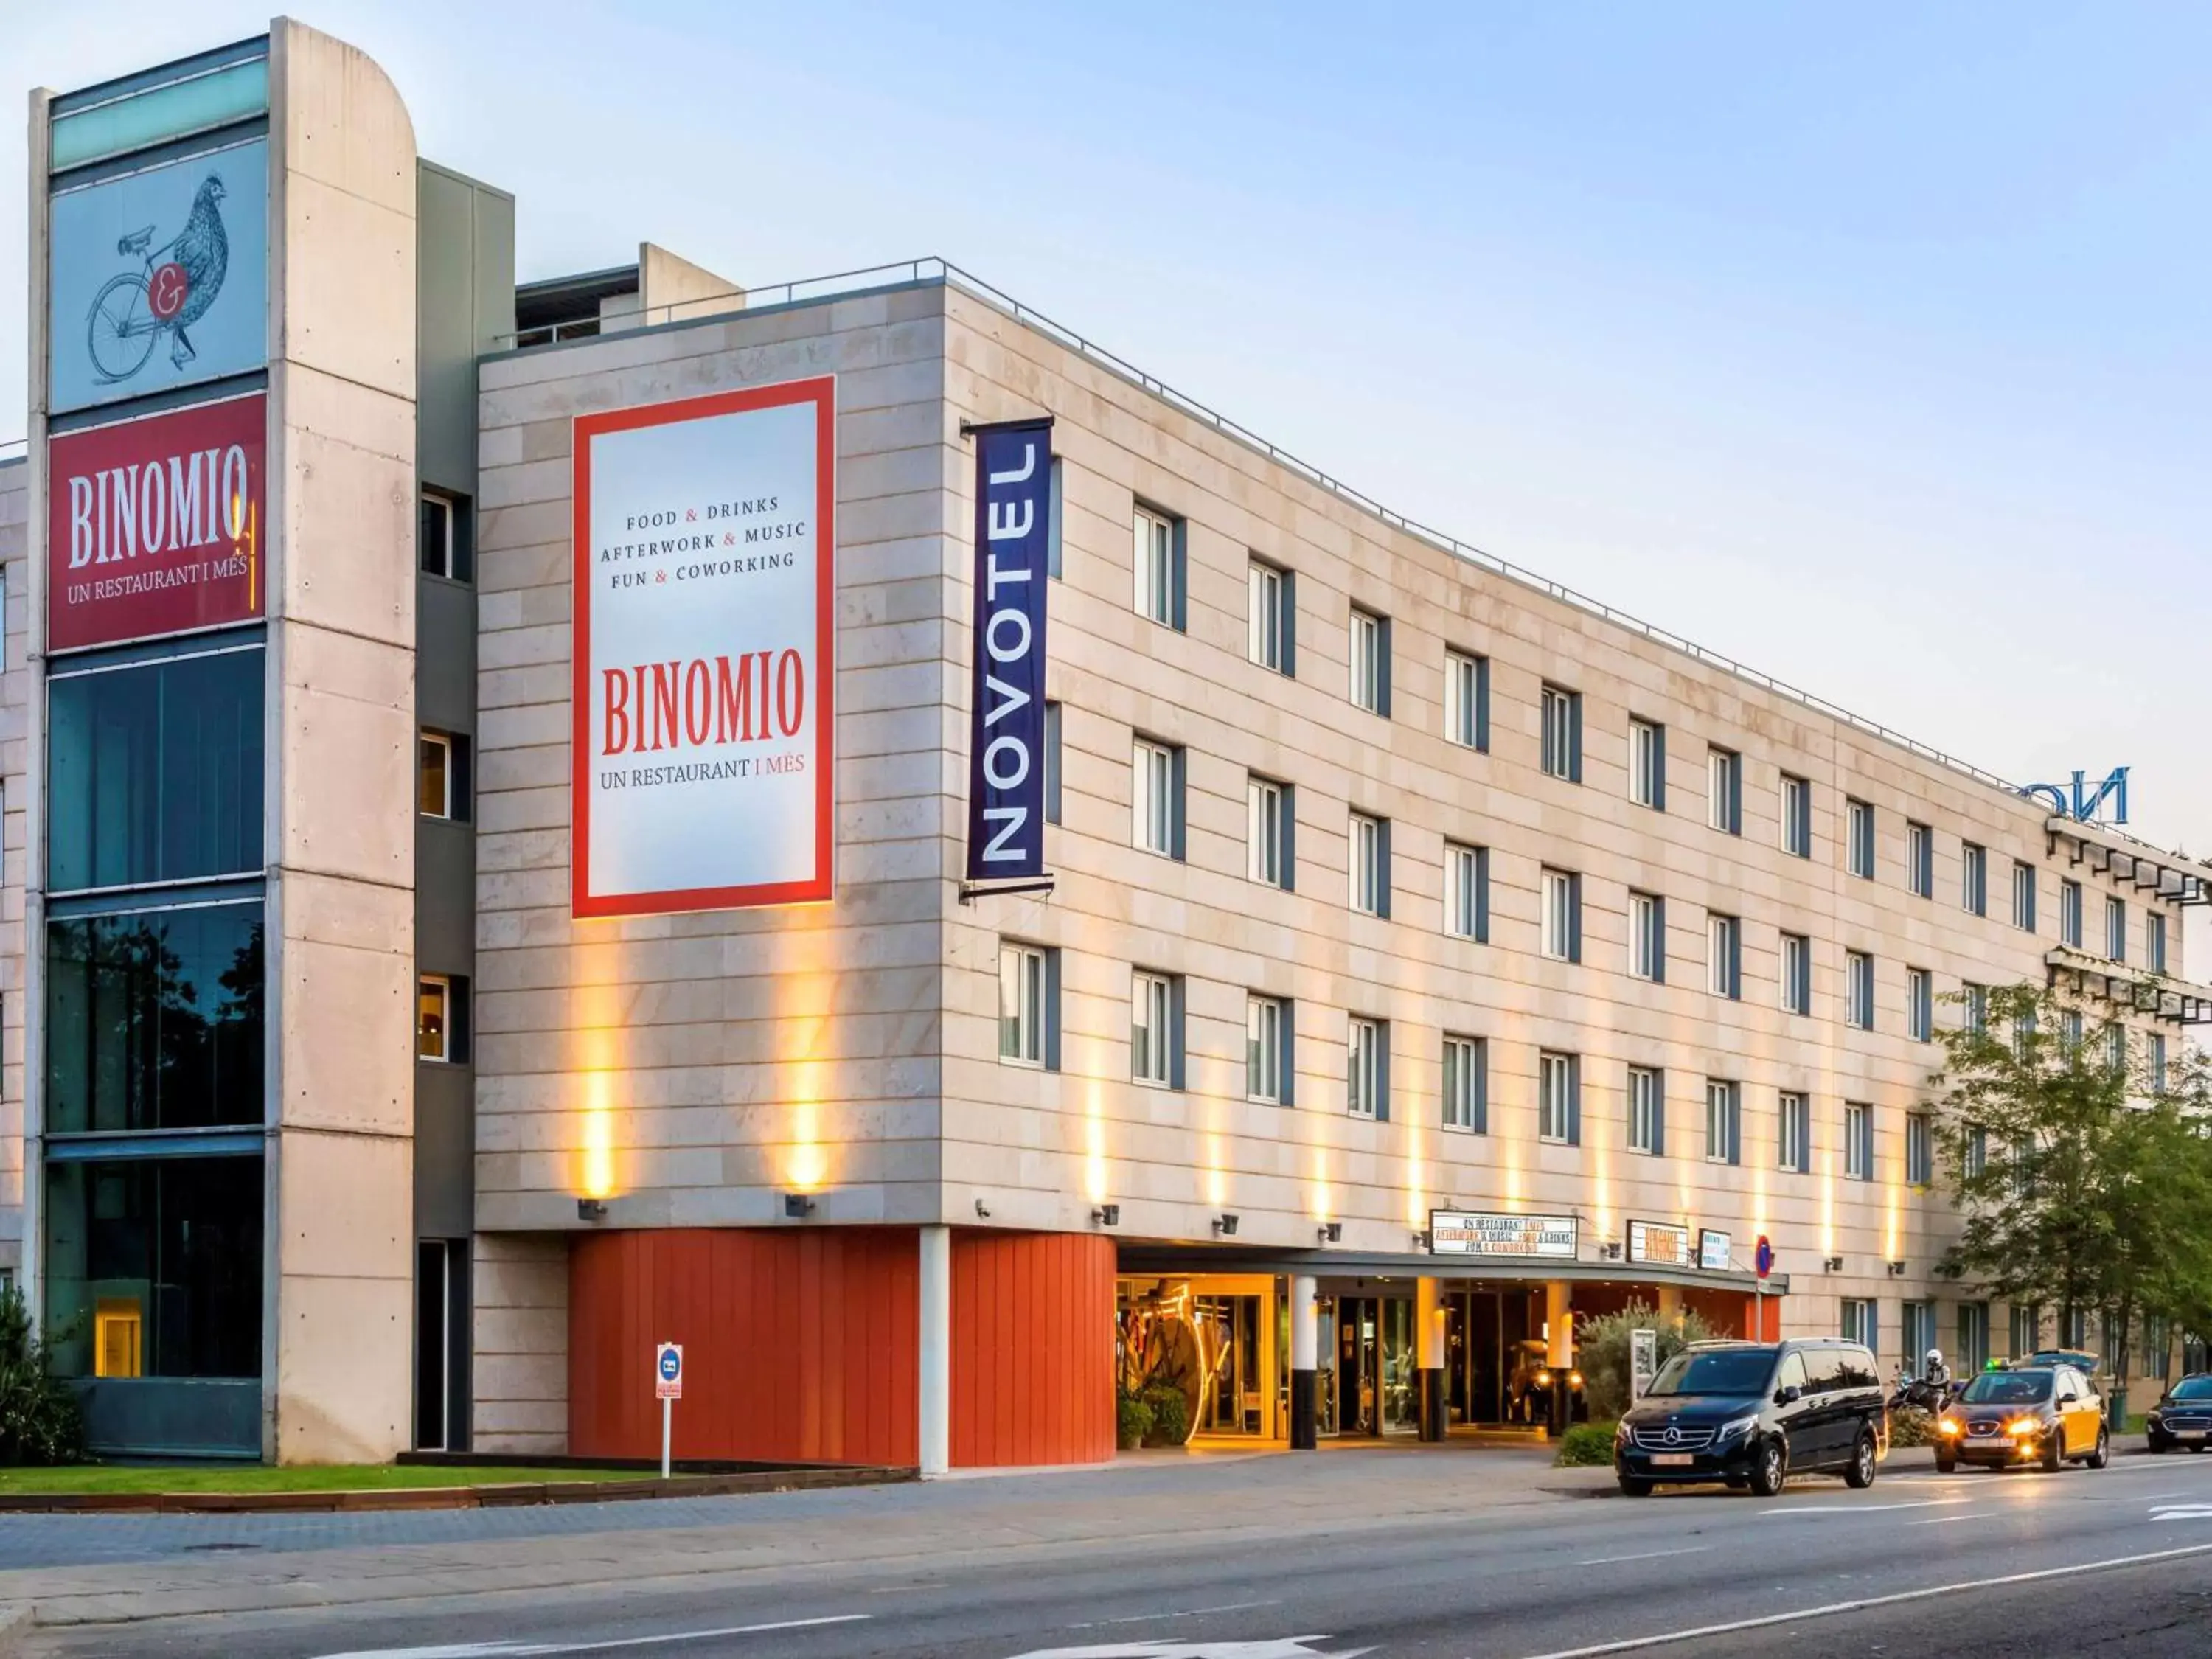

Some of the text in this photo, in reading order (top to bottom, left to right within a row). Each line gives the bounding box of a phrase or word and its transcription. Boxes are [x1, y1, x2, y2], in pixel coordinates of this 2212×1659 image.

[157, 266, 183, 314] &
[68, 444, 248, 569] BINOMIO
[627, 496, 779, 531] FOOD & DRINKS
[600, 522, 806, 563] AFTERWORK & MUSIC
[68, 582, 91, 605] UN
[95, 563, 200, 600] RESTAURANT
[203, 562, 209, 581] I
[611, 552, 794, 589] FUN & COWORKING
[981, 443, 1035, 862] NOVOTEL
[602, 648, 804, 756] BINOMIO
[601, 751, 805, 790] UN RESTAURANT I MÉS
